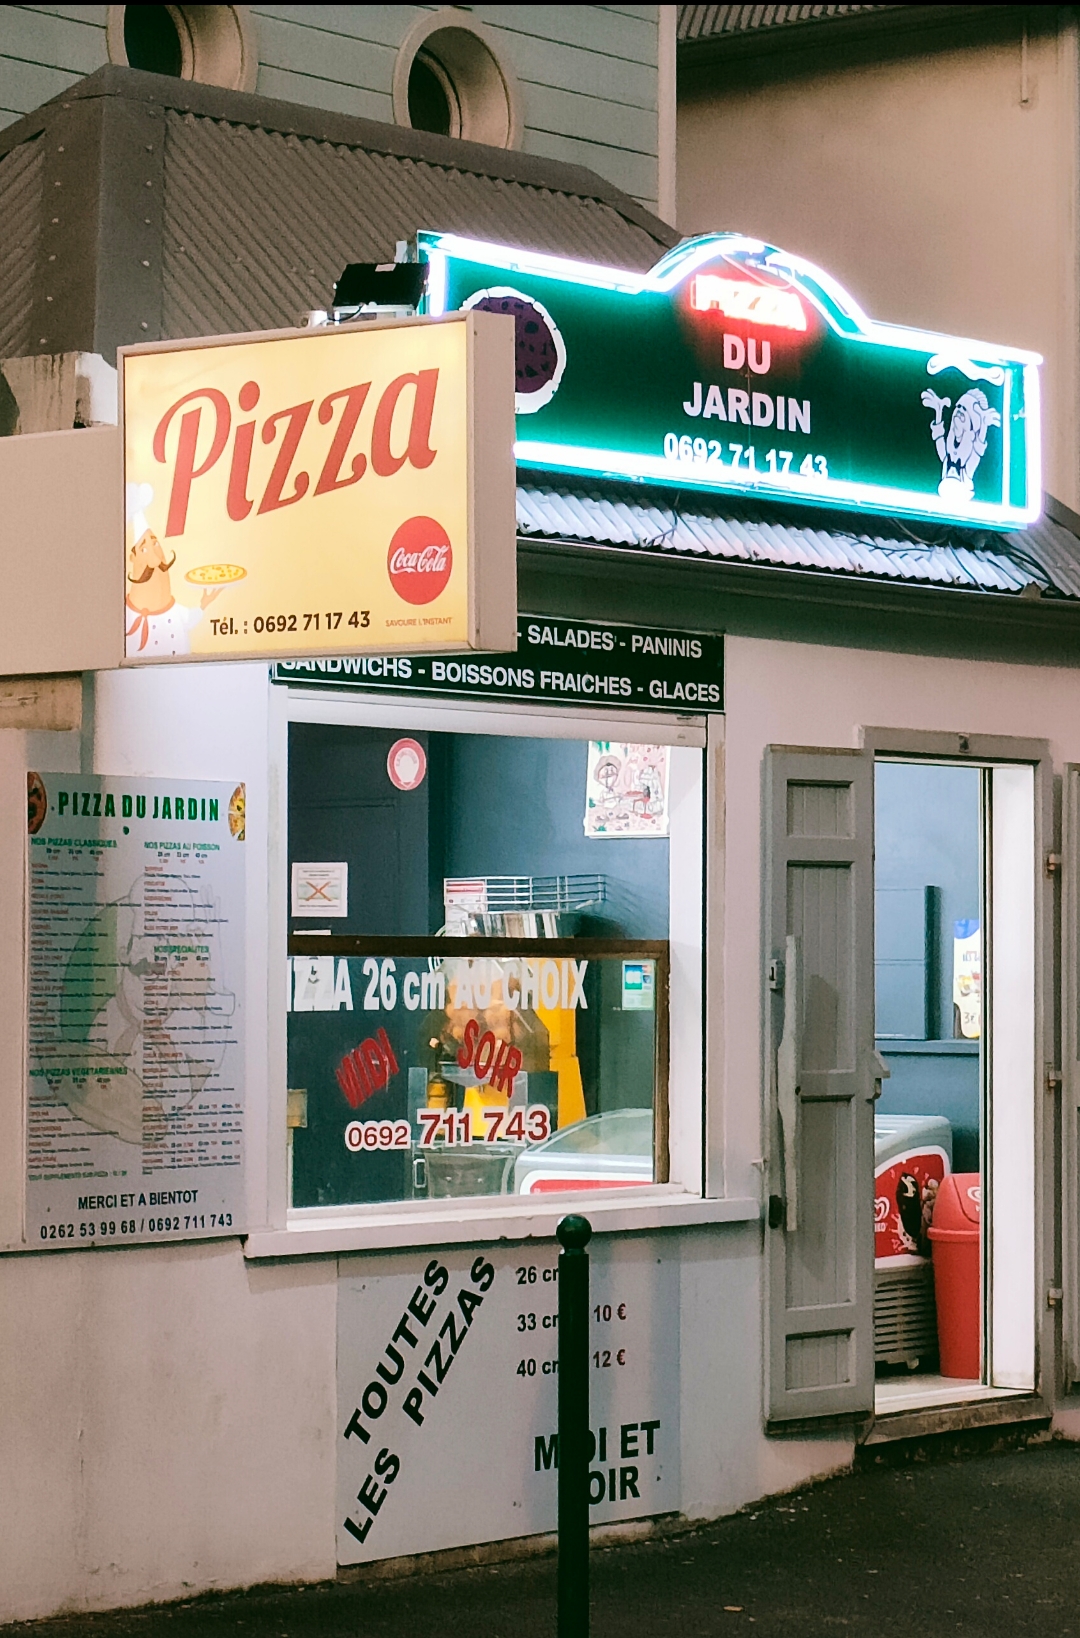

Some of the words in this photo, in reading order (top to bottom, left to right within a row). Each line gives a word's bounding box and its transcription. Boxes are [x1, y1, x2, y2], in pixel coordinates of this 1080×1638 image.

[723, 333, 771, 375] DU
[682, 382, 811, 434] JARDIN
[152, 367, 440, 538] Pizza
[663, 432, 722, 465] 0692
[729, 443, 756, 471] 71
[765, 449, 793, 474] 17
[800, 454, 829, 479] 43
[389, 544, 449, 575] Coca-Cola
[210, 617, 239, 636] Tél.
[253, 614, 298, 633] 0692
[303, 613, 320, 631] 71
[325, 612, 343, 630] 17
[348, 610, 370, 628] 43
[385, 618, 417, 628] SAVOURE
[527, 625, 615, 651] SALADES
[631, 635, 703, 658] PANINIS
[431, 661, 535, 688] BOISSONS
[540, 671, 632, 696] FRAICHES
[649, 679, 720, 703] GLACES
[58, 791, 116, 818] PIZZA
[122, 794, 147, 818] DU
[152, 796, 219, 822] JARDIN
[159, 842, 181, 850] PIZZAS
[362, 958, 397, 1011] 26
[403, 971, 446, 1011] cm
[453, 959, 493, 1010] AU
[502, 959, 589, 1010] CHOIX
[335, 1026, 400, 1109] MIDI
[457, 1018, 523, 1099] SOIR
[347, 1124, 409, 1147] 0692
[419, 1113, 471, 1145] 711
[484, 1109, 549, 1142] 743
[78, 1194, 118, 1210] MERCI
[120, 1193, 136, 1207] ET
[138, 1192, 147, 1206] A
[149, 1189, 198, 1206] BIENTOT
[40, 1224, 75, 1239] 0262
[79, 1222, 96, 1237] 53
[100, 1221, 116, 1235] 99
[120, 1220, 136, 1233] 68
[149, 1216, 180, 1232] 0692
[184, 1215, 206, 1229] 711
[210, 1213, 233, 1227] 743
[517, 1266, 537, 1285] 26
[517, 1313, 537, 1332] 33
[593, 1305, 612, 1322] 10
[617, 1303, 627, 1320] €
[343, 1259, 449, 1444] TOUTES
[516, 1358, 536, 1377] 40
[593, 1351, 611, 1368] 12
[616, 1349, 626, 1366] €
[343, 1448, 400, 1544] LES
[402, 1256, 495, 1427] PIZZAS
[620, 1419, 661, 1458] ET
[588, 1466, 641, 1505] OIR
